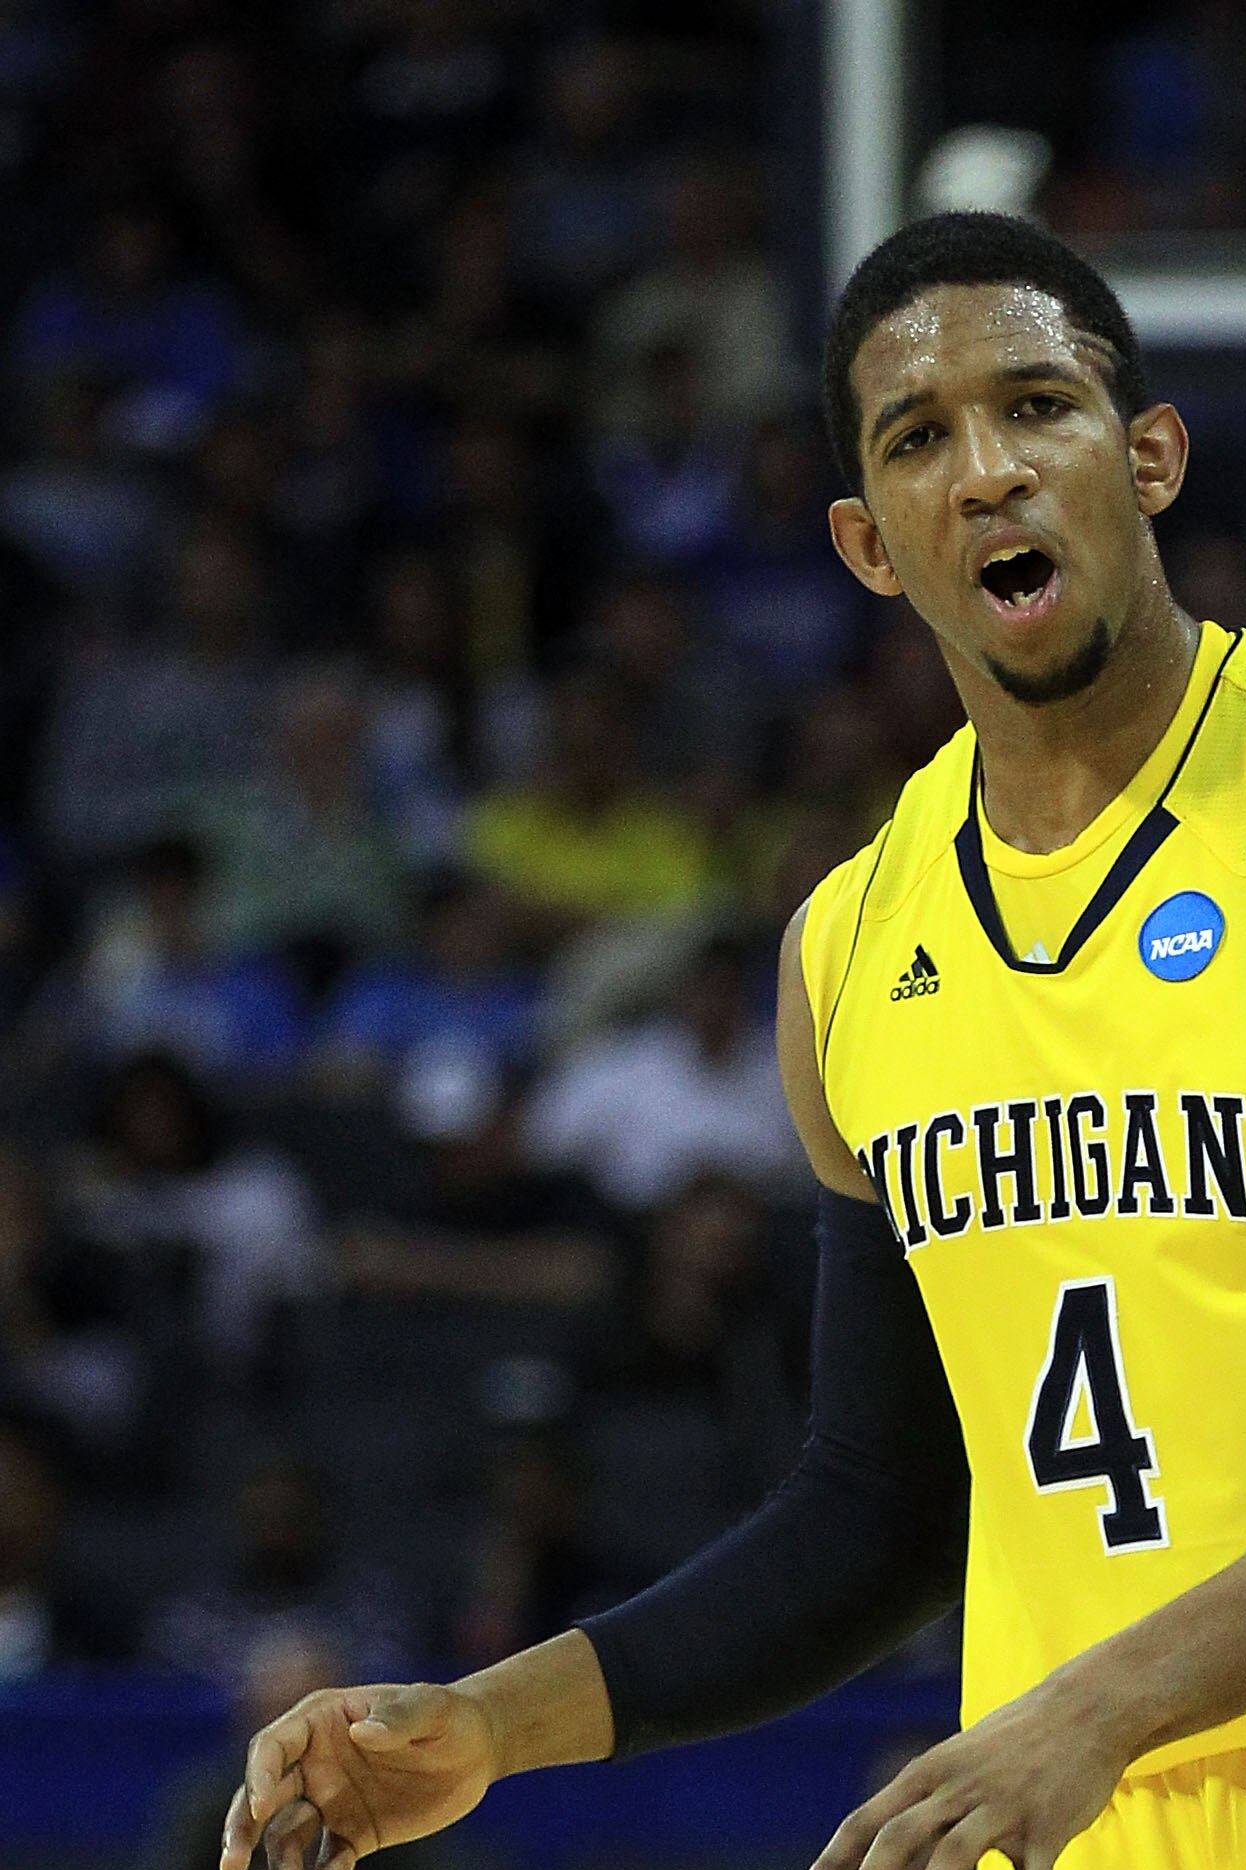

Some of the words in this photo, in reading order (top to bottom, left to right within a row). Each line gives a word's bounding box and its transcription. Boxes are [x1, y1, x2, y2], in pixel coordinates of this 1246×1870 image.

[1150, 929, 1213, 961] NCAA
[889, 975, 941, 1002] adida
[1023, 1274, 1171, 1557] 4
